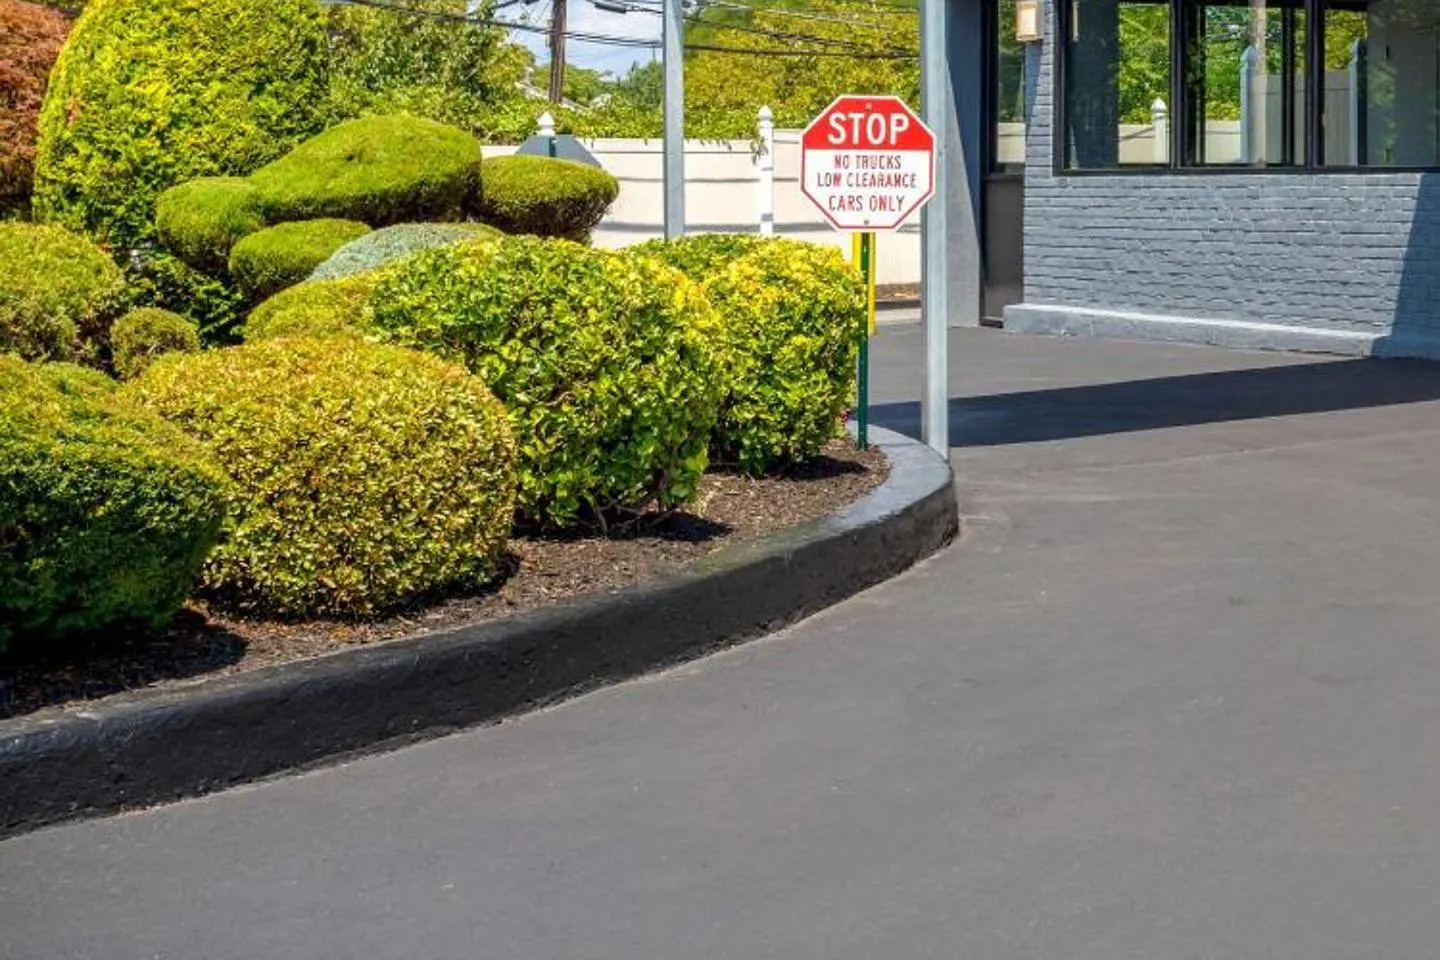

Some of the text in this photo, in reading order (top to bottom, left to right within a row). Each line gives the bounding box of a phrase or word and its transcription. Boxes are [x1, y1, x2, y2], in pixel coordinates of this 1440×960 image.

[827, 112, 909, 145] STOP
[834, 154, 902, 169] NO TRUCKS
[816, 172, 917, 188] LOW CLEARANCE
[828, 195, 905, 212] CARS ONLY
